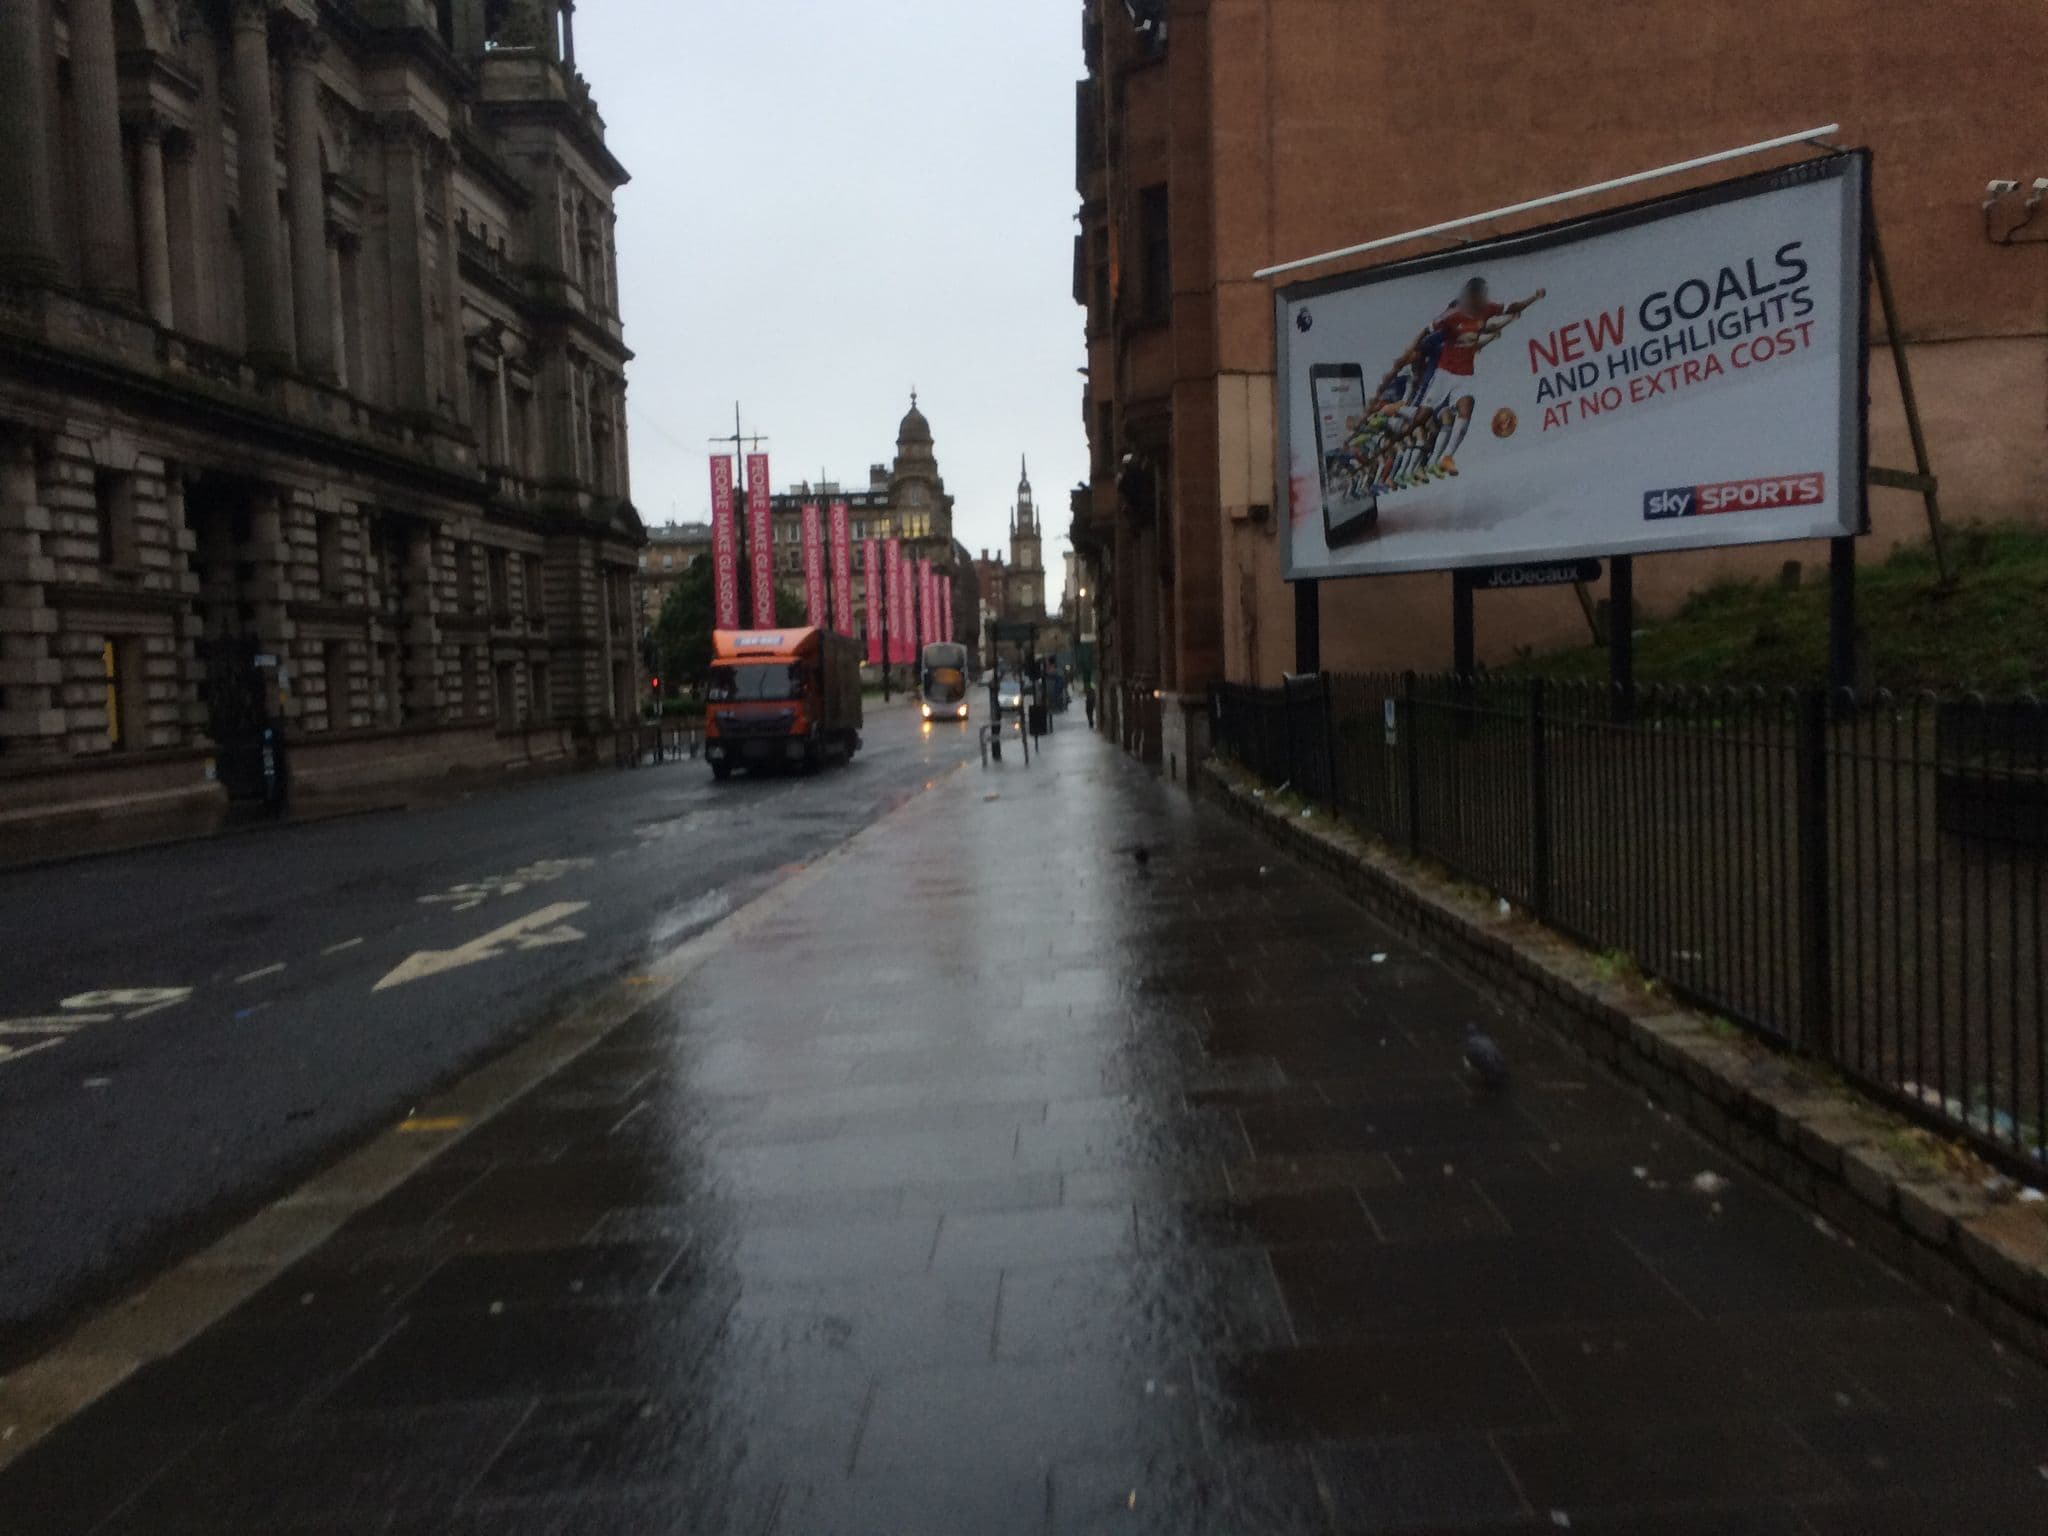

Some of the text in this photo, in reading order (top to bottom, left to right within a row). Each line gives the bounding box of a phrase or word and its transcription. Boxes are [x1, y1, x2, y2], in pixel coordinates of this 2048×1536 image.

[1528, 241, 1808, 374] NEW GOALS
[1536, 286, 1814, 404] AND HIGHLIGHTS
[1543, 320, 1815, 431] AT NO EXTRA COST
[715, 458, 734, 625] PEOPLE MAKE GLASGOW
[751, 457, 770, 625] PEOPLE MAKE GLASGOW
[1648, 476, 1819, 517] sky SPORTS
